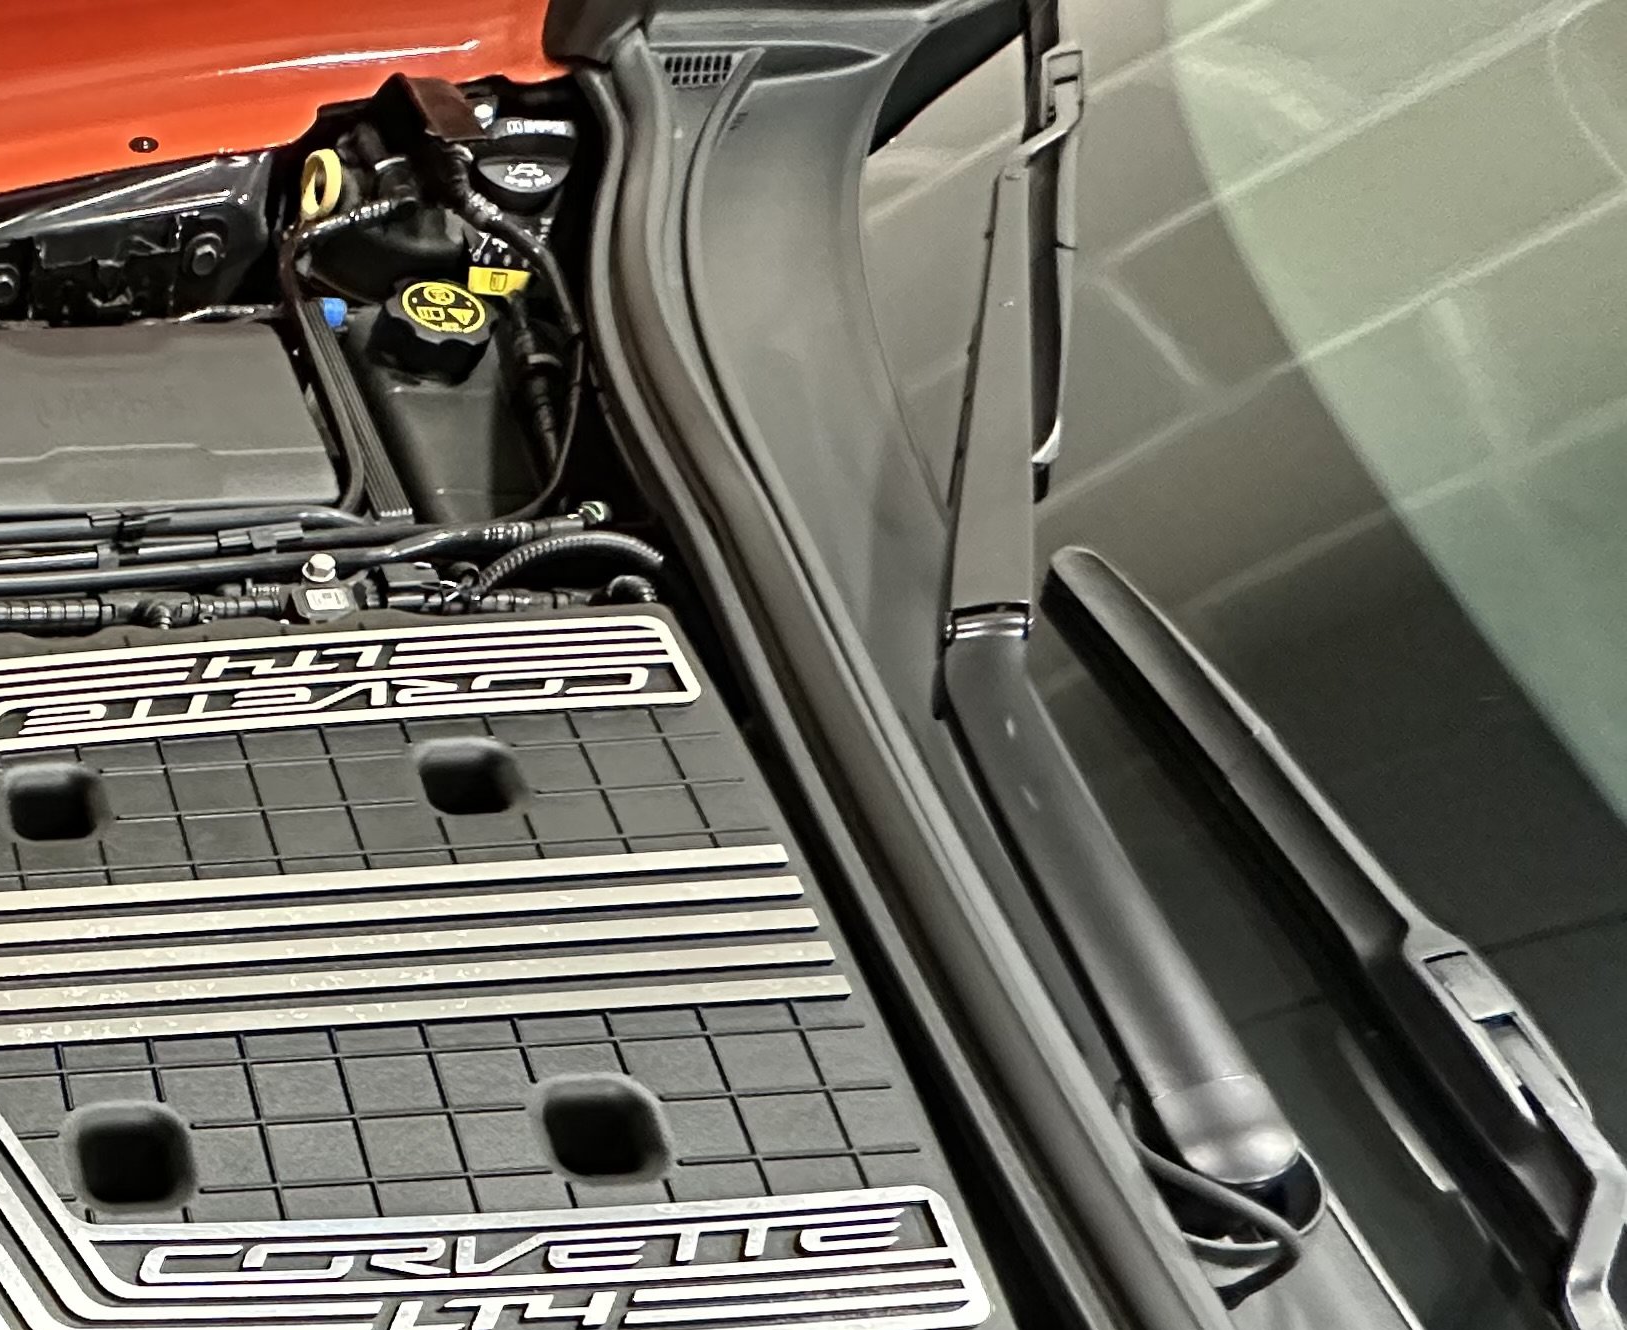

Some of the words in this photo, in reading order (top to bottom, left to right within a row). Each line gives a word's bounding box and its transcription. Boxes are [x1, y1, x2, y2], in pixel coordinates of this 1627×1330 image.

[200, 643, 387, 685] LT4
[19, 666, 651, 736] CORVETTE
[138, 1207, 906, 1285] CORVETTE
